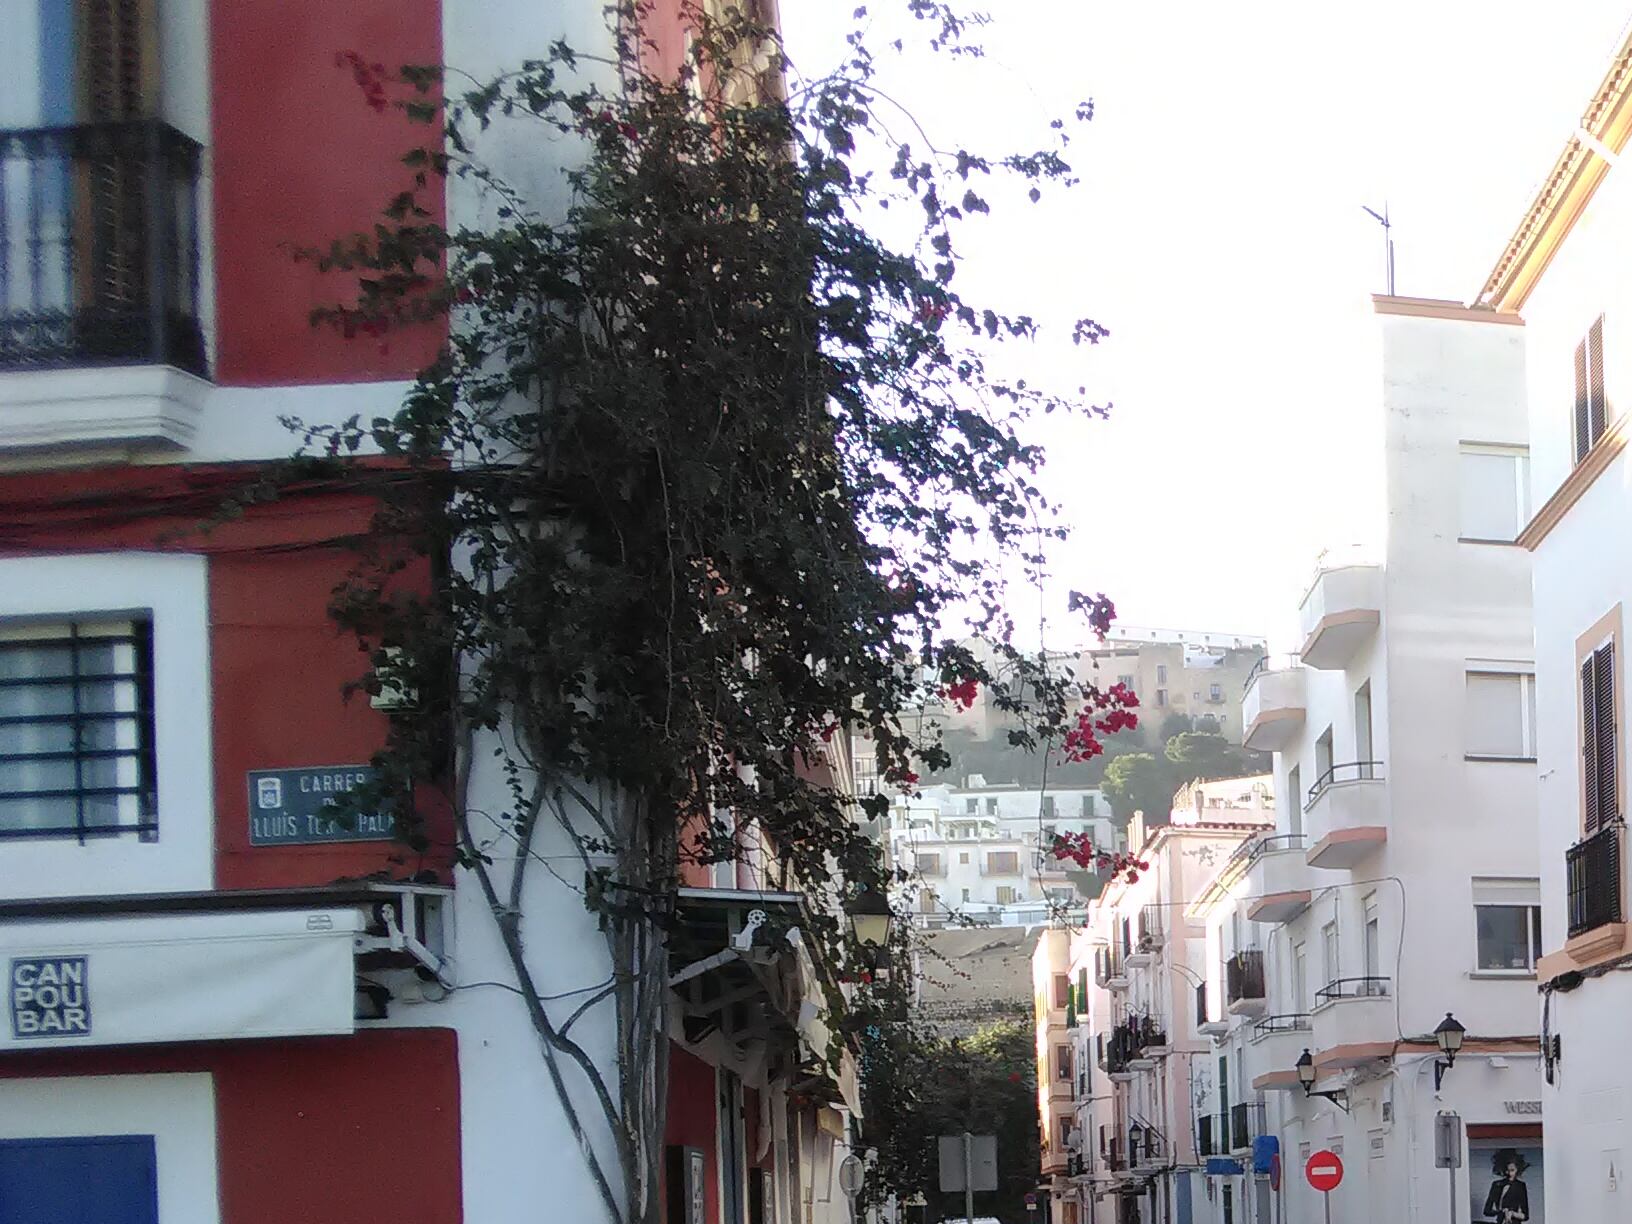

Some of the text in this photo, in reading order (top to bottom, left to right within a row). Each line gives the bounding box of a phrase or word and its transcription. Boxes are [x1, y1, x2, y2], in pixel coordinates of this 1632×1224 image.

[15, 962, 83, 986] CAN
[15, 985, 84, 1010] POU
[16, 1008, 87, 1033] BAR
